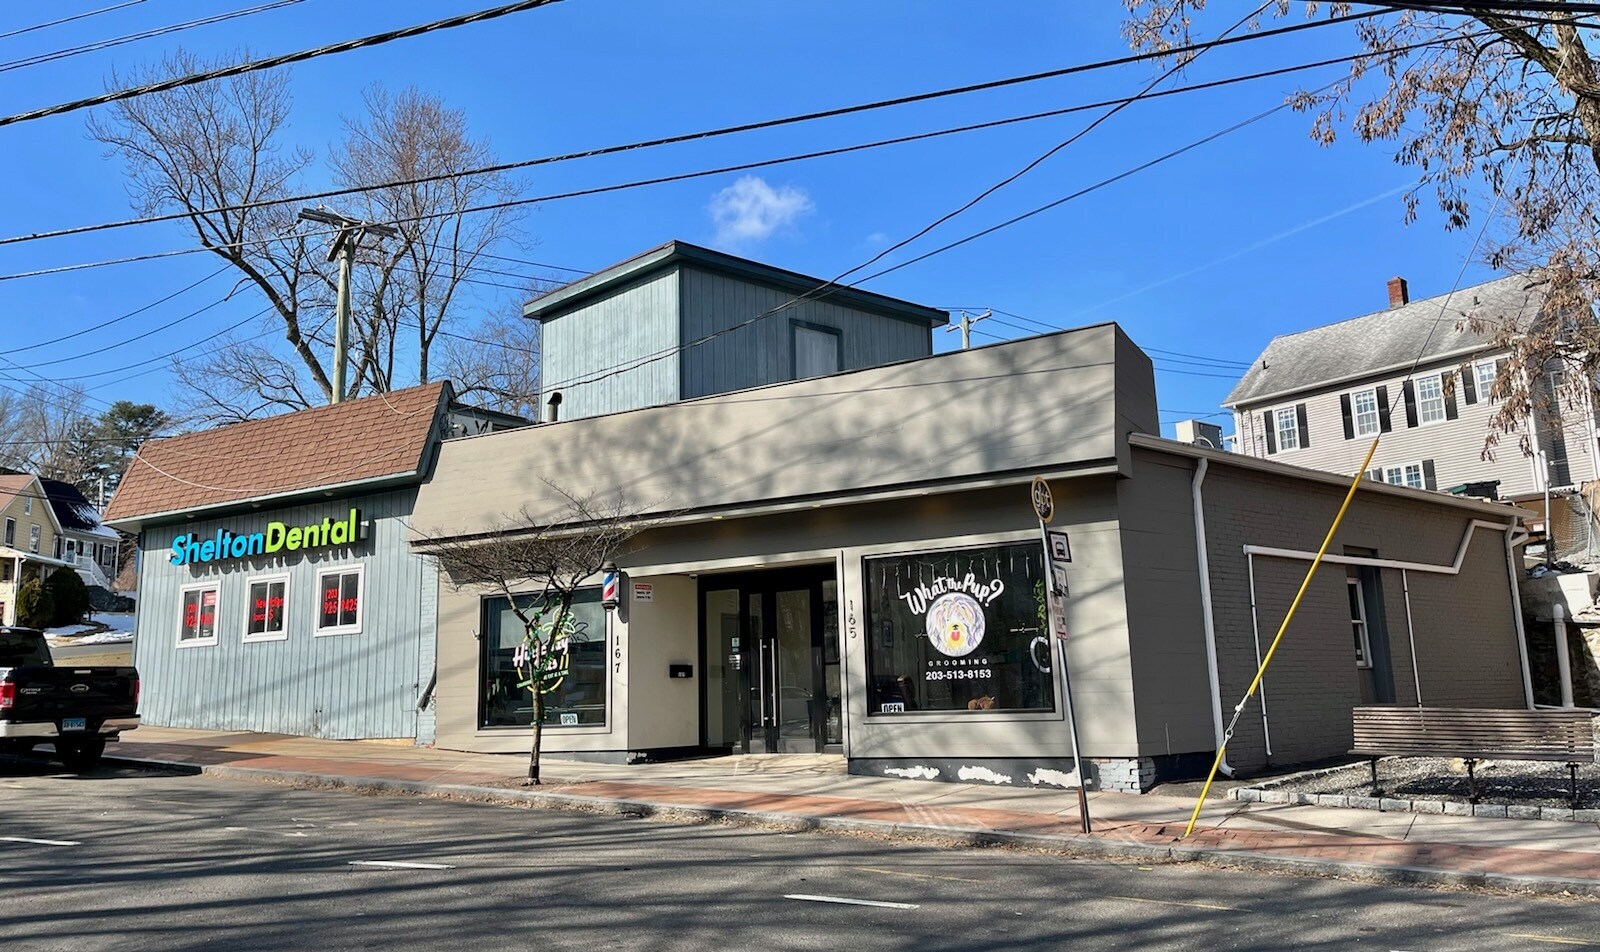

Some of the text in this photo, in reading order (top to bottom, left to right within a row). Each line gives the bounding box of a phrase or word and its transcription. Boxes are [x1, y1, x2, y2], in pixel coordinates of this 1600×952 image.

[899, 572, 1004, 615] What the Pup?
[848, 599, 856, 638] 165
[928, 658, 987, 667] GROOMING
[925, 669, 991, 680] 203-513-8153
[883, 704, 902, 712] OPEN
[562, 715, 577, 724] OPEN
